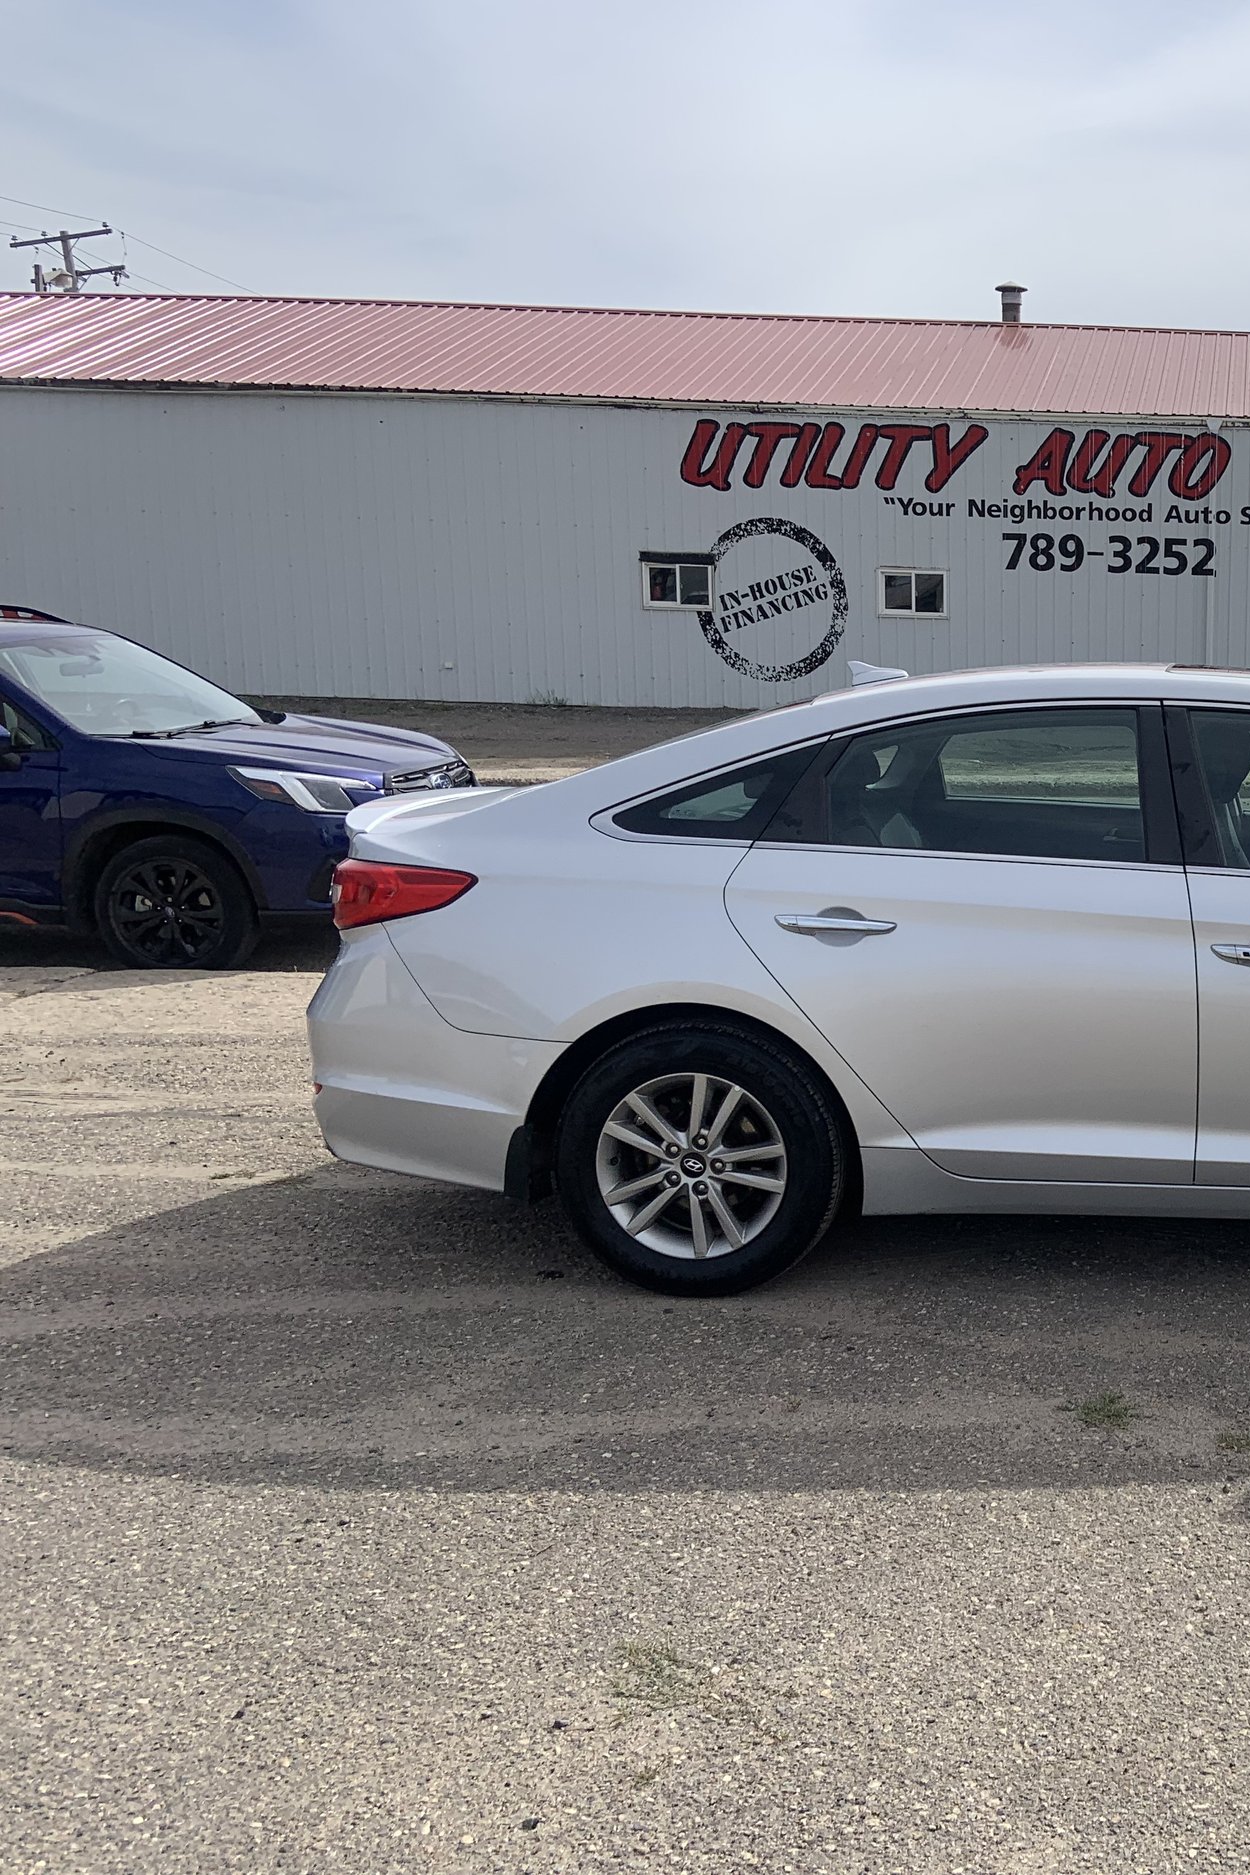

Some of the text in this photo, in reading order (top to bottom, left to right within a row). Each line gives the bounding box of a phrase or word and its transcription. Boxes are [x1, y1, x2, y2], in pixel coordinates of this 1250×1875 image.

[680, 419, 988, 493] UTILITY
[1012, 427, 1232, 501] AUTO
[967, 498, 1153, 524] Neighborhood
[1164, 504, 1232, 525] Auto
[1002, 532, 1217, 577] 789-3252
[719, 565, 817, 611] IN-HOUSE
[720, 583, 828, 633] FINANCING
